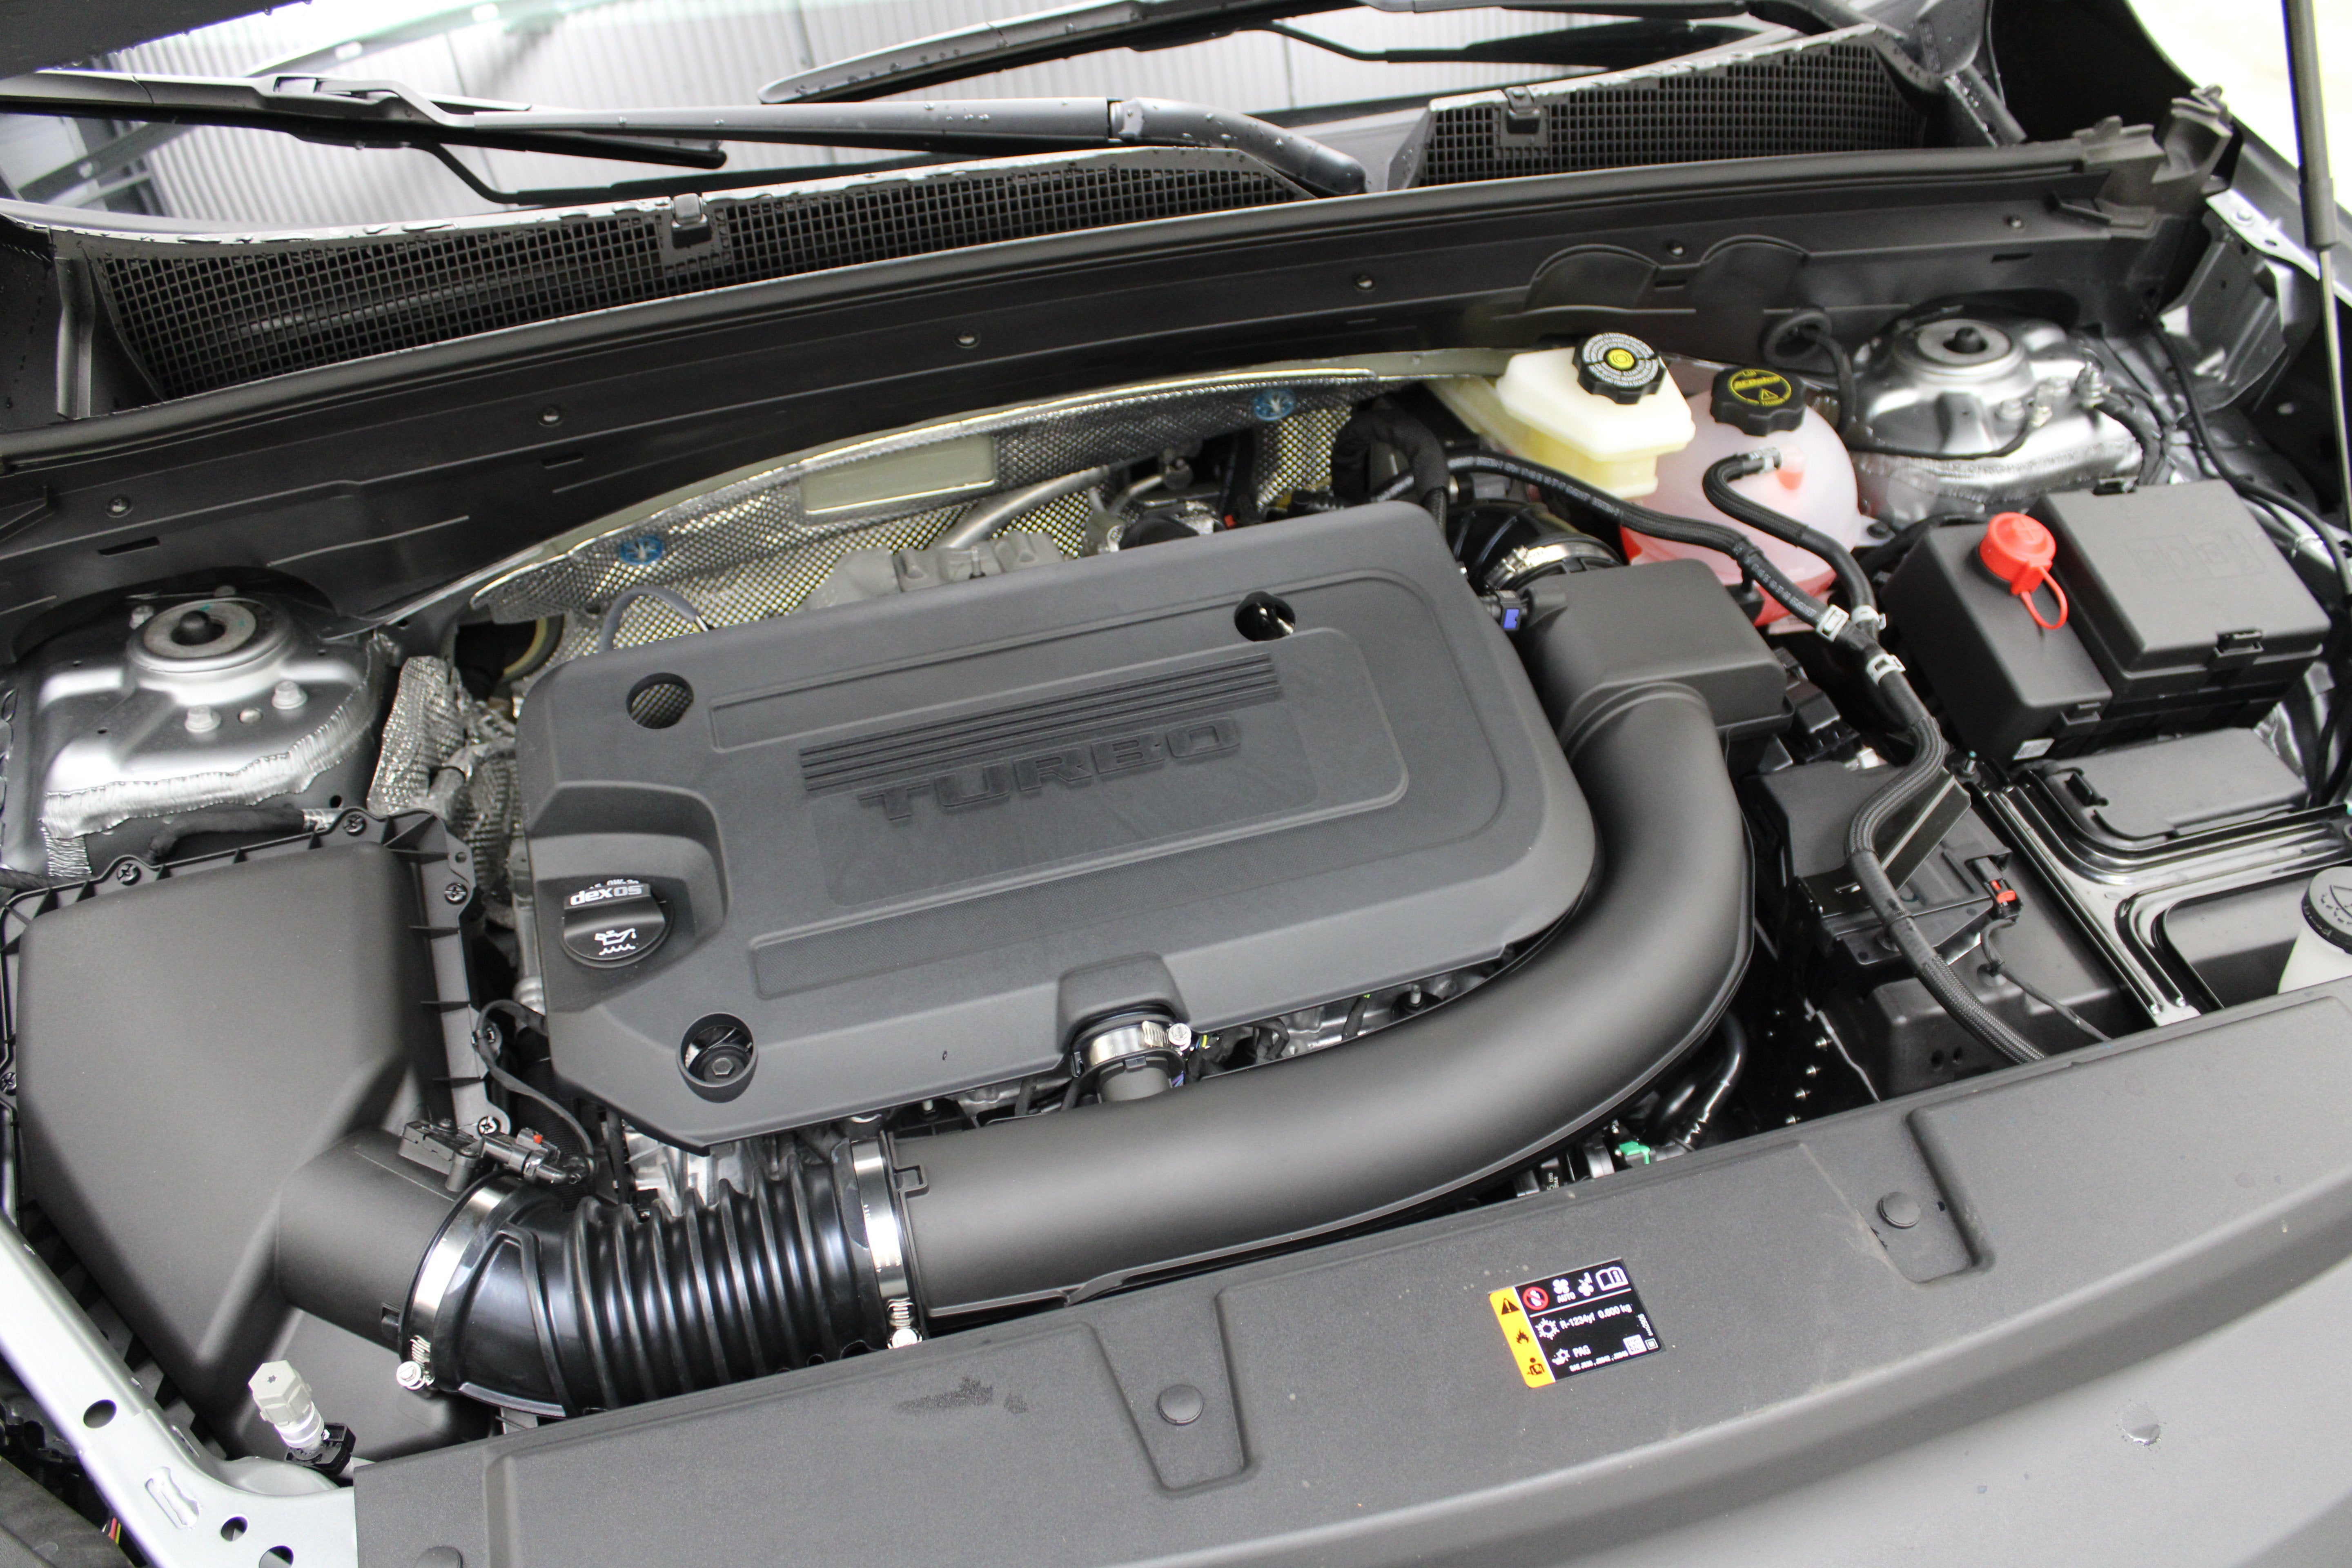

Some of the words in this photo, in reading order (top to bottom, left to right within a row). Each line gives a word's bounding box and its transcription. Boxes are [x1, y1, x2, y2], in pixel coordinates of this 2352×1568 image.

[858, 717, 1240, 821] TURBO
[570, 885, 644, 906] dexos
[1557, 1292, 1576, 1303] AUTO
[1559, 1312, 1596, 1330] R-1234yf
[1597, 1306, 1621, 1319] 0.600
[1619, 1304, 1633, 1313] kg
[1572, 1345, 1592, 1358] PAG
